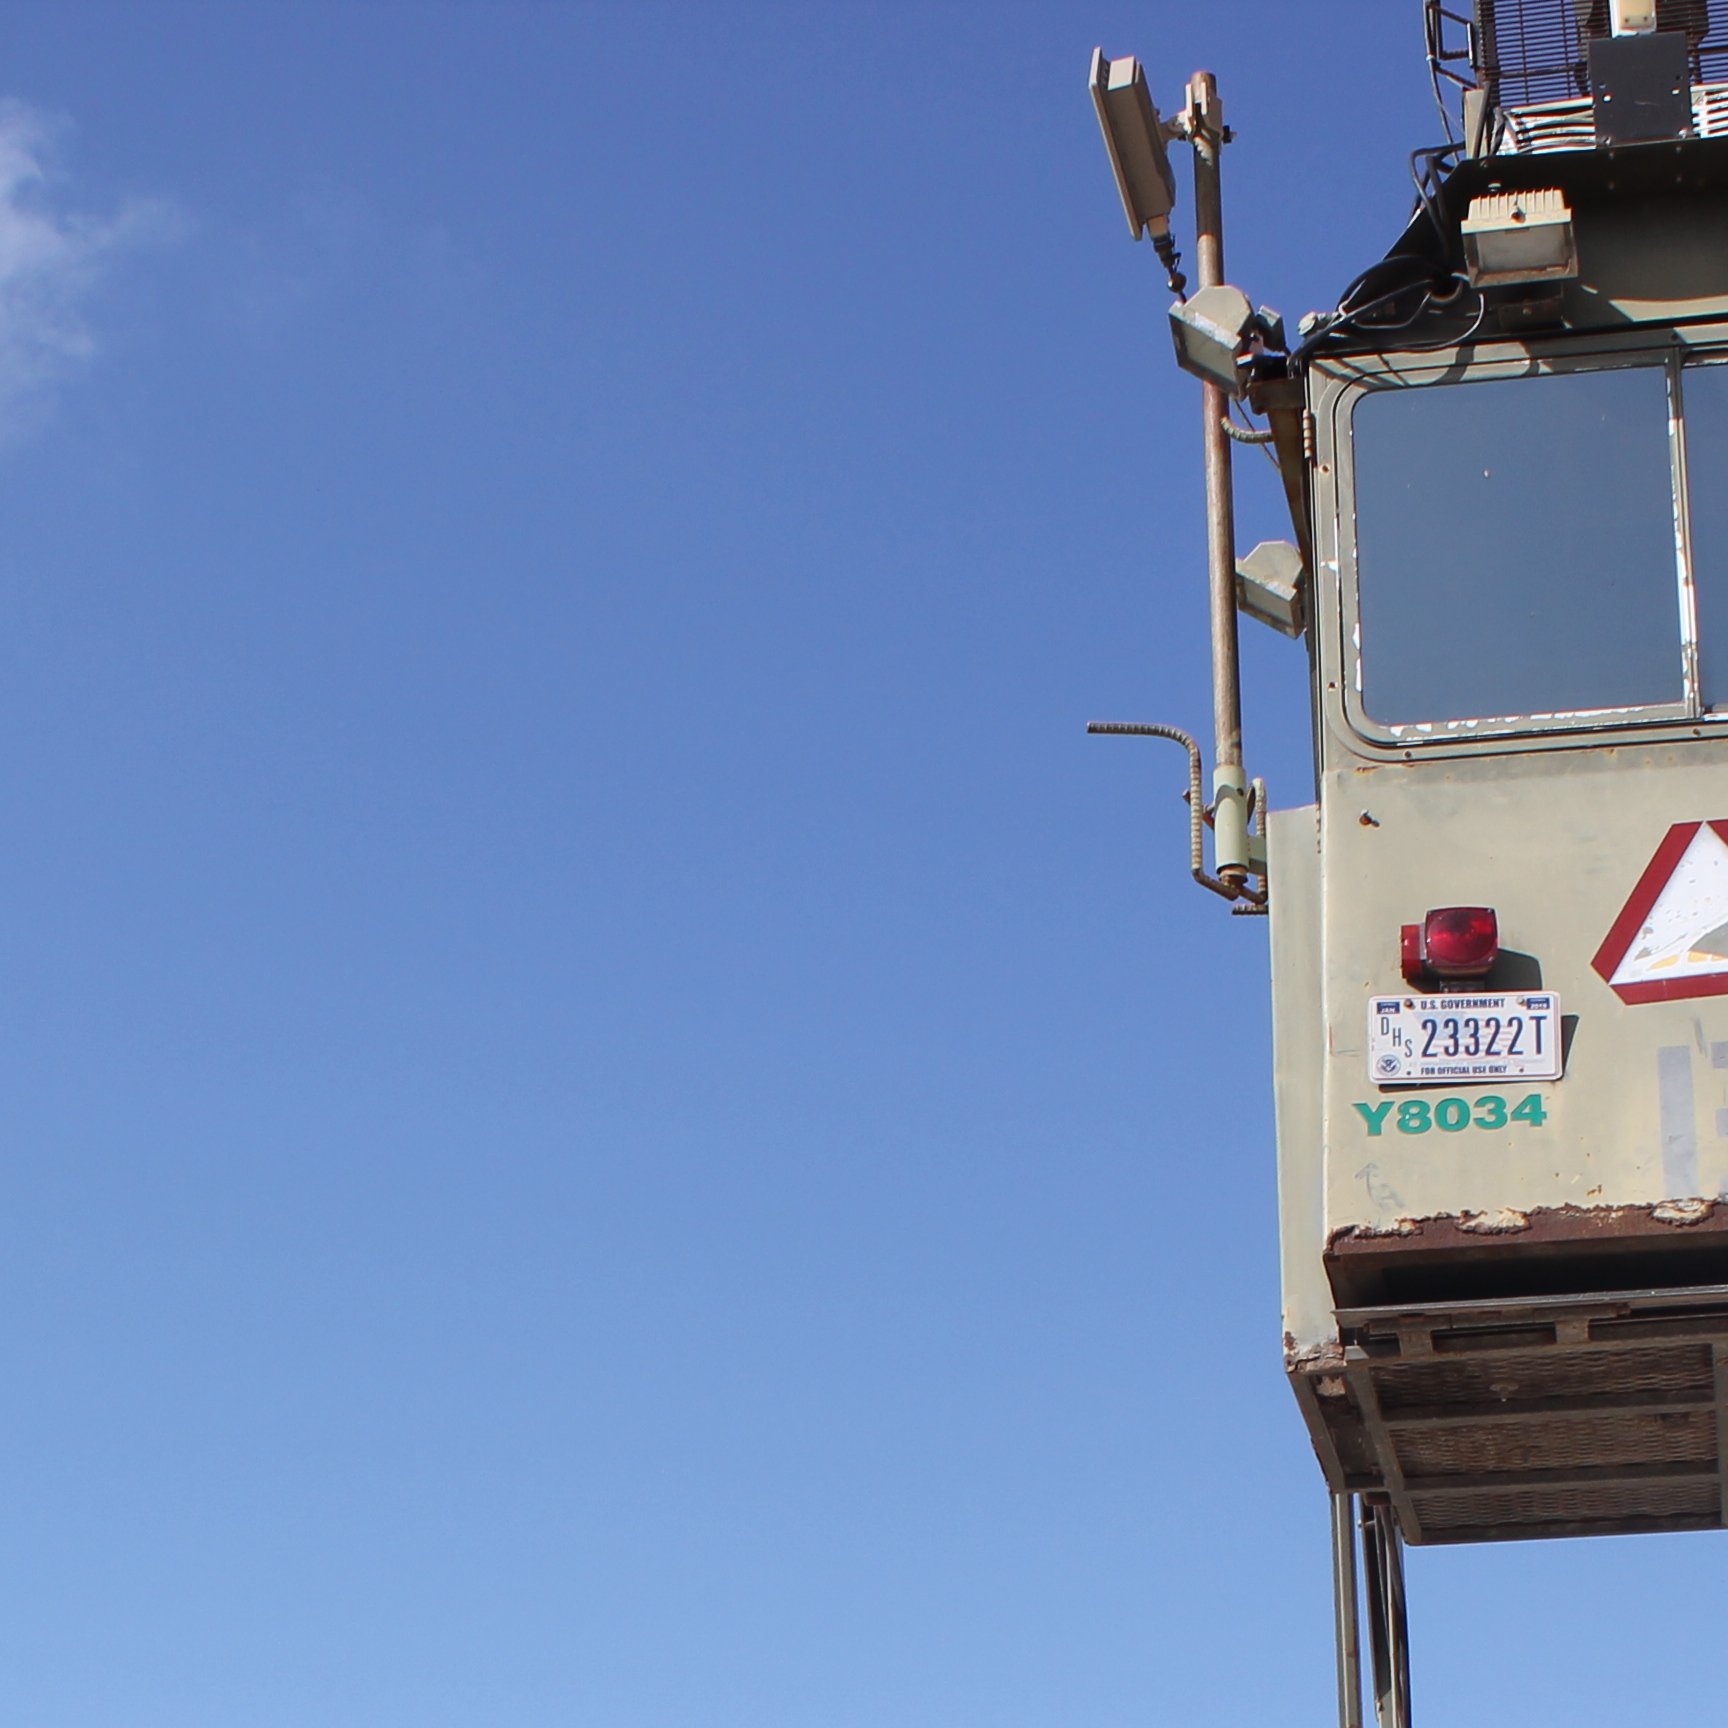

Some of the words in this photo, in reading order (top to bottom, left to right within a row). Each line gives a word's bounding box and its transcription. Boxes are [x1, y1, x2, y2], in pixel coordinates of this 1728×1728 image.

[1420, 1000, 1439, 1010] U.S.
[1440, 998, 1505, 1010] GOVERNMENT
[1421, 1015, 1548, 1058] 23322T
[1420, 1067, 1436, 1076] FOR
[1437, 1066, 1471, 1075] OFFICIAL
[1472, 1065, 1487, 1075] USE
[1488, 1065, 1508, 1074] ONLY
[1353, 1093, 1547, 1136] Y8034
